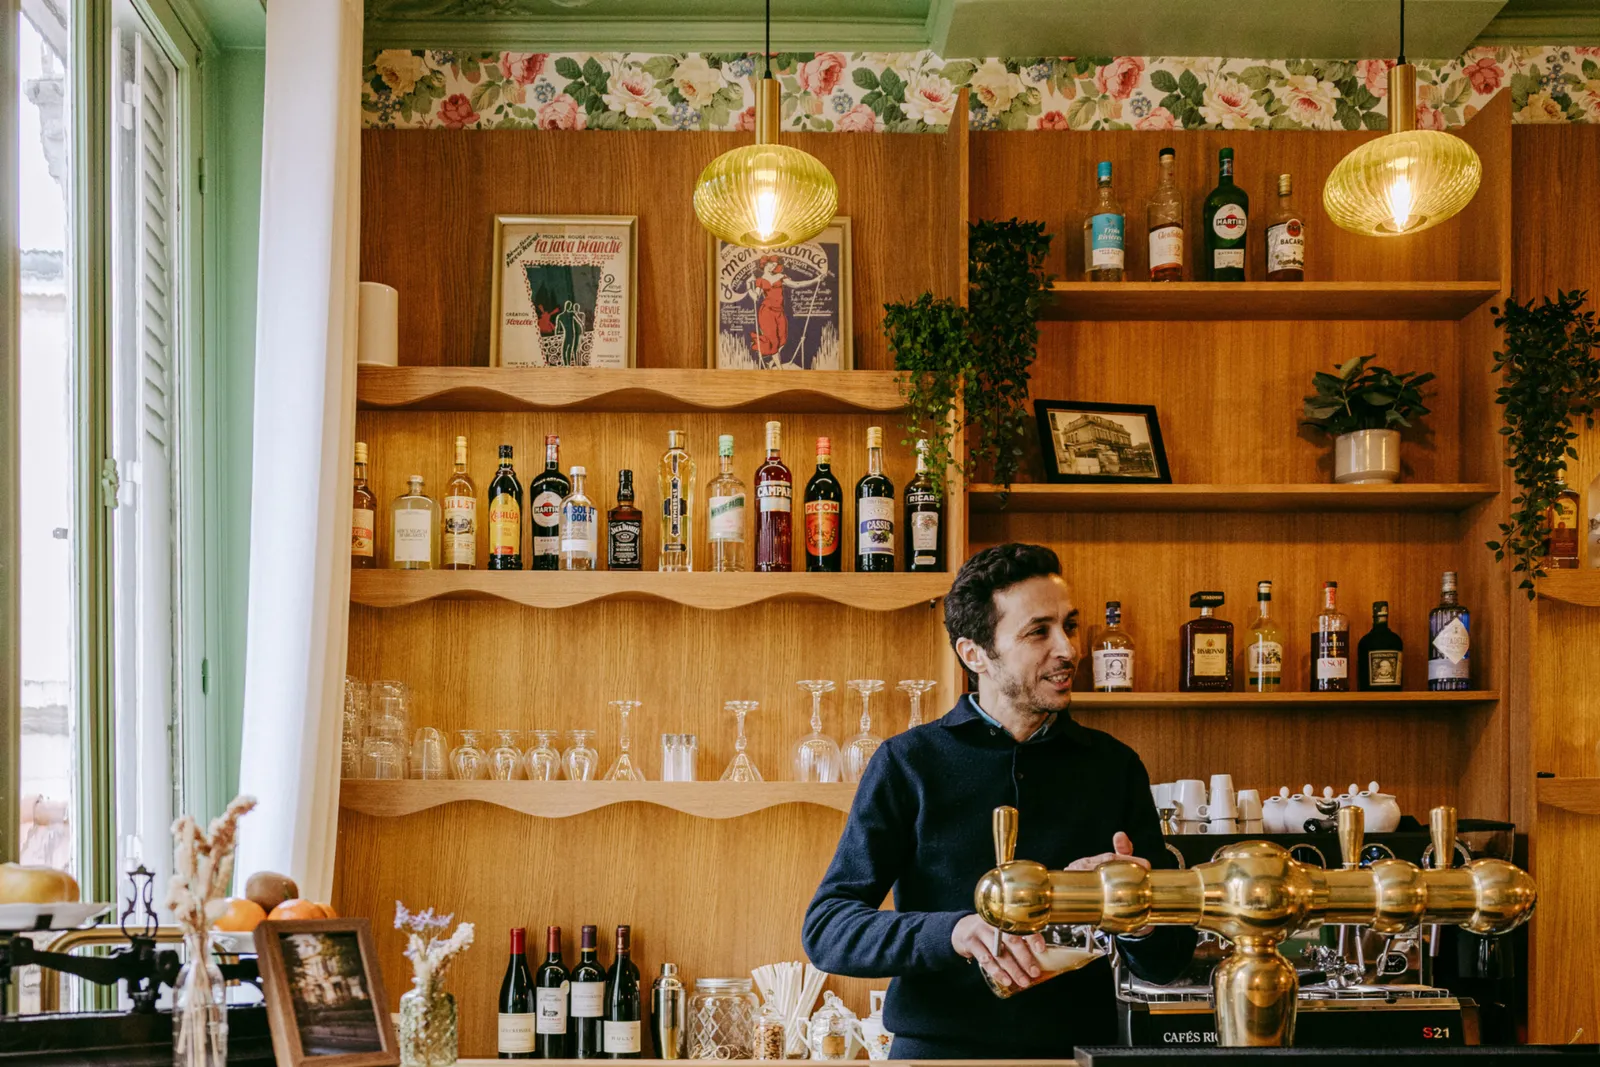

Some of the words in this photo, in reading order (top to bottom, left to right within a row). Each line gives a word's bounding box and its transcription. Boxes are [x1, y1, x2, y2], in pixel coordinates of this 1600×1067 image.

[1217, 218, 1244, 226] MARTINI
[600, 305, 621, 315] REVUE
[909, 495, 936, 503] RICAR
[563, 505, 595, 516] ASOLUT
[806, 503, 838, 513] PICON
[610, 524, 622, 535] JACK
[866, 520, 891, 531] CASSIS
[1322, 660, 1345, 668] VSOP
[1163, 1030, 1201, 1043] CAFÉS
[1422, 1027, 1450, 1039] S21
